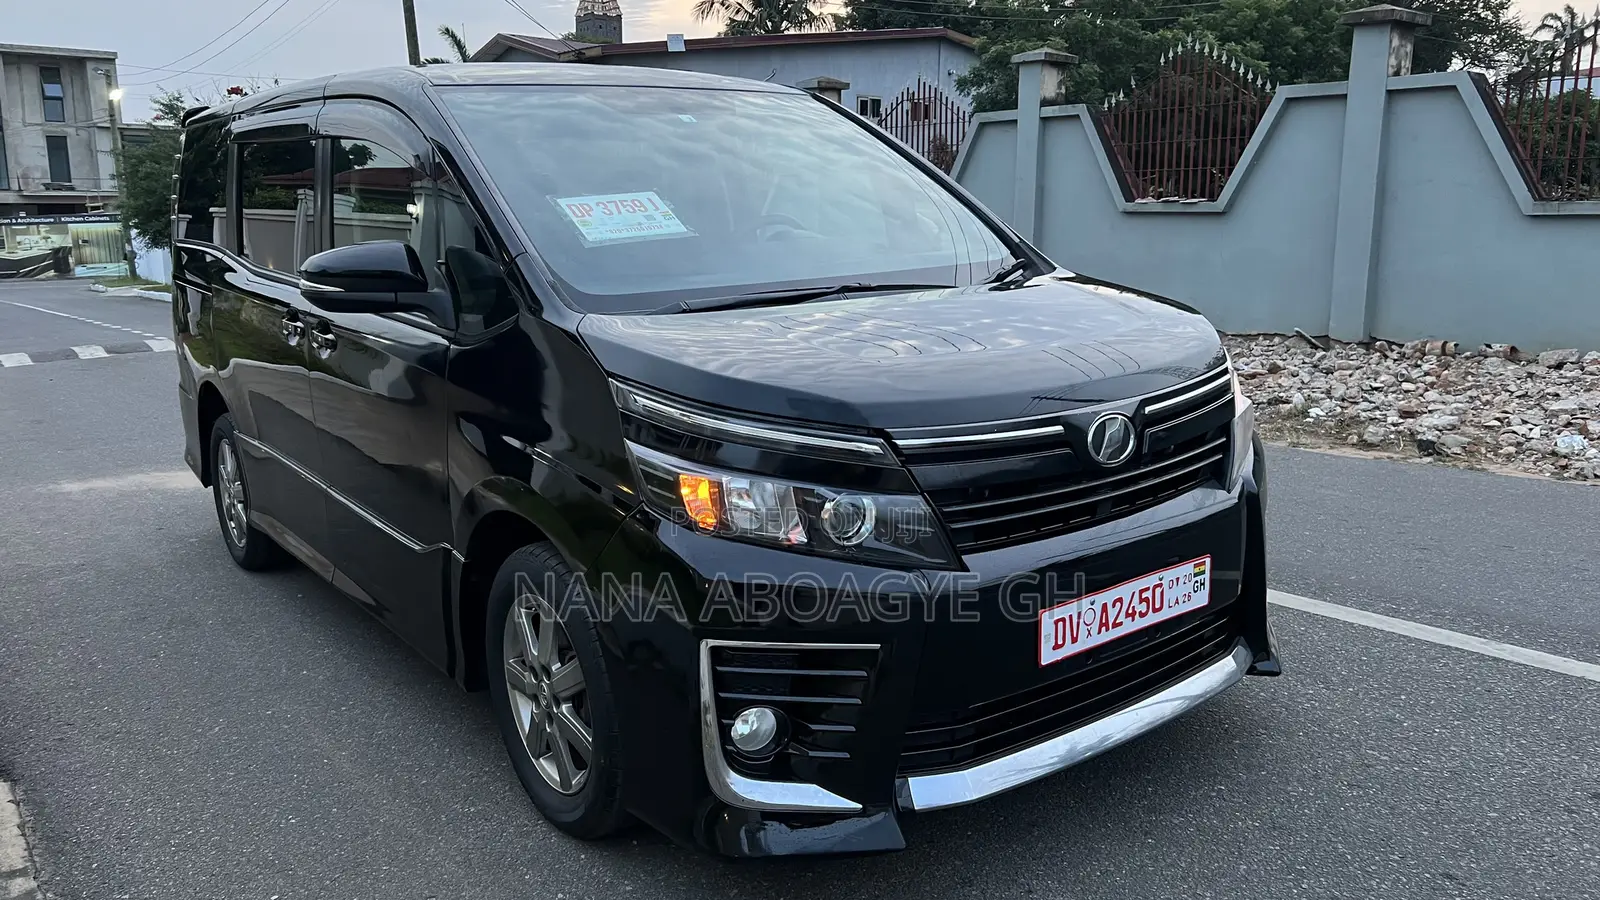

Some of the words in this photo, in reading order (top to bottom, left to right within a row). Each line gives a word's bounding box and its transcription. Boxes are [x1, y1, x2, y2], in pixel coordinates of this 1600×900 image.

[566, 203, 594, 218] DP
[596, 198, 648, 216] 3759
[1183, 572, 1193, 585] 20
[1193, 577, 1206, 594] GH
[1168, 596, 1180, 609] LA
[1182, 591, 1192, 604] 26
[1052, 610, 1082, 650] DV
[1097, 582, 1164, 635] A2450
